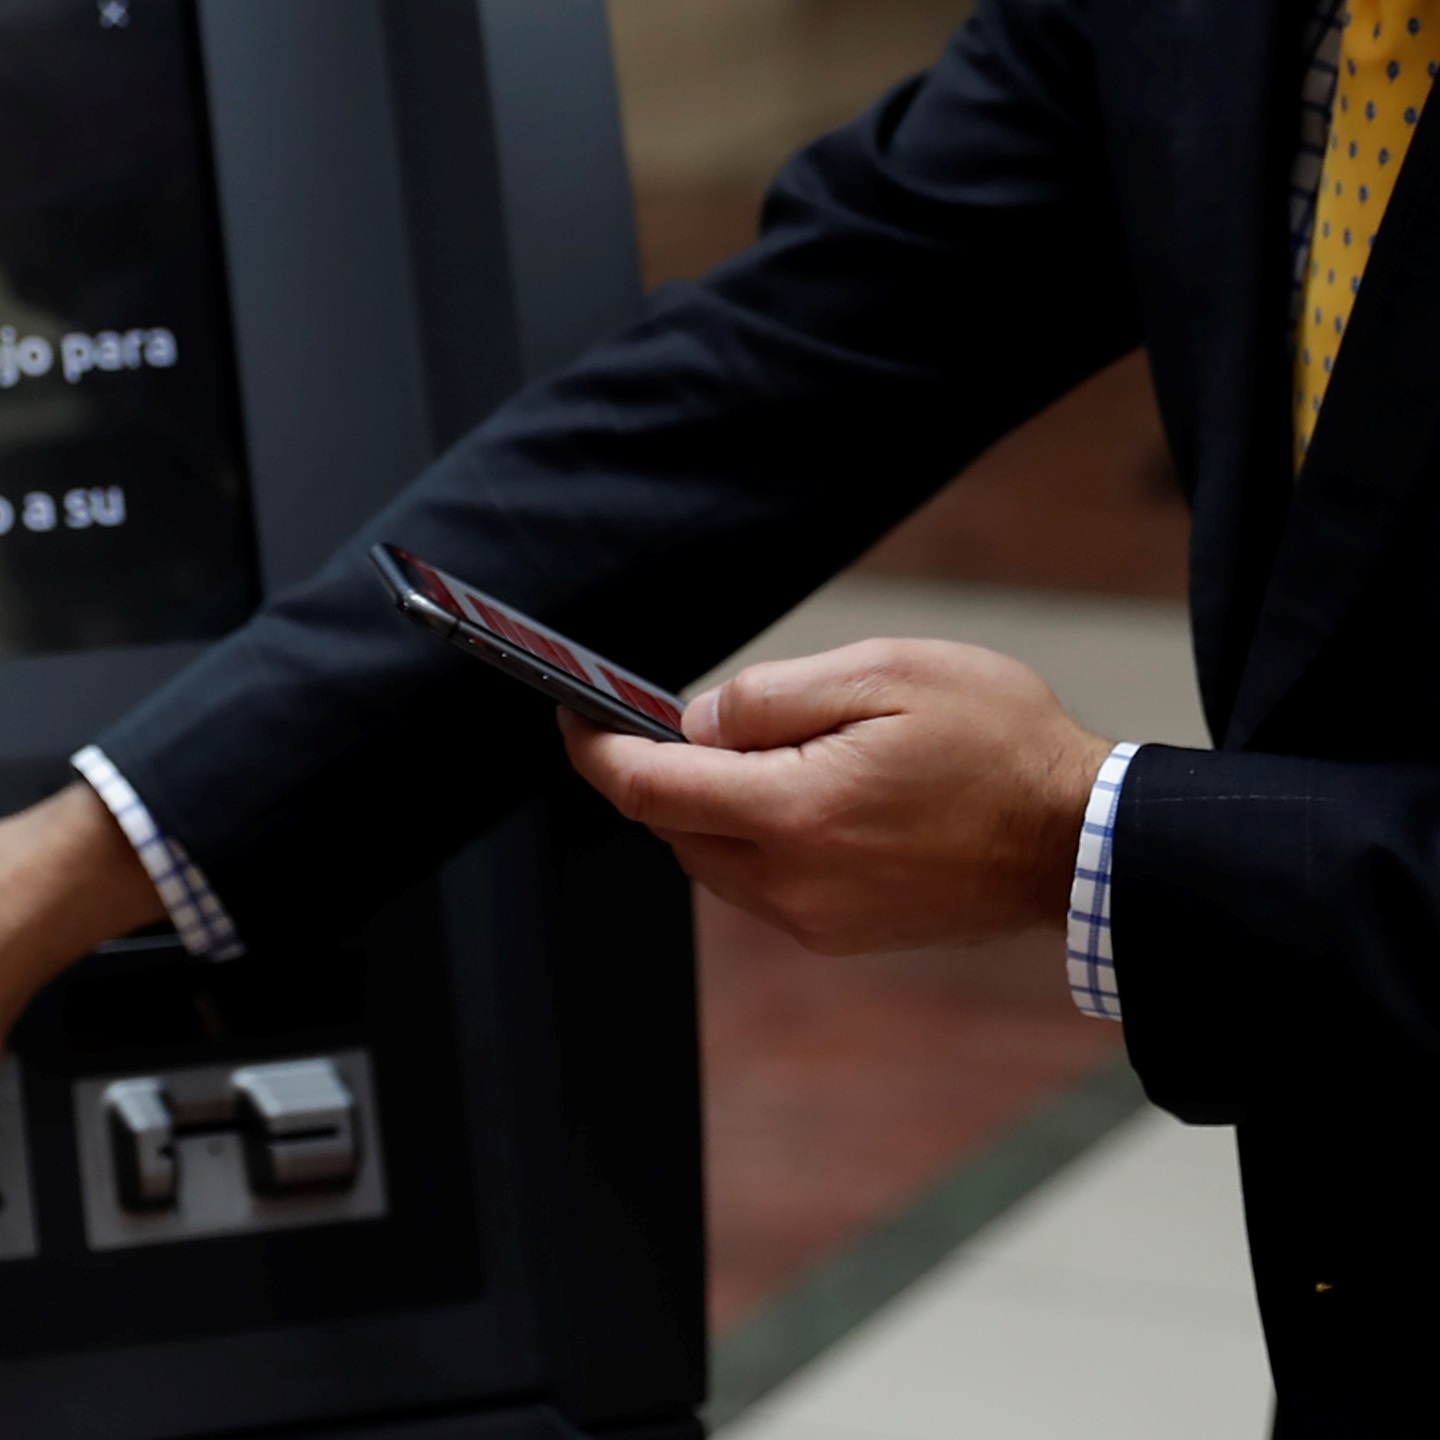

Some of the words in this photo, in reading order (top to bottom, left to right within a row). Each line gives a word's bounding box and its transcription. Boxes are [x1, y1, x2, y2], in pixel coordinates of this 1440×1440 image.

[60, 327, 178, 382] para
[23, 490, 56, 530] a
[64, 485, 127, 531] su
